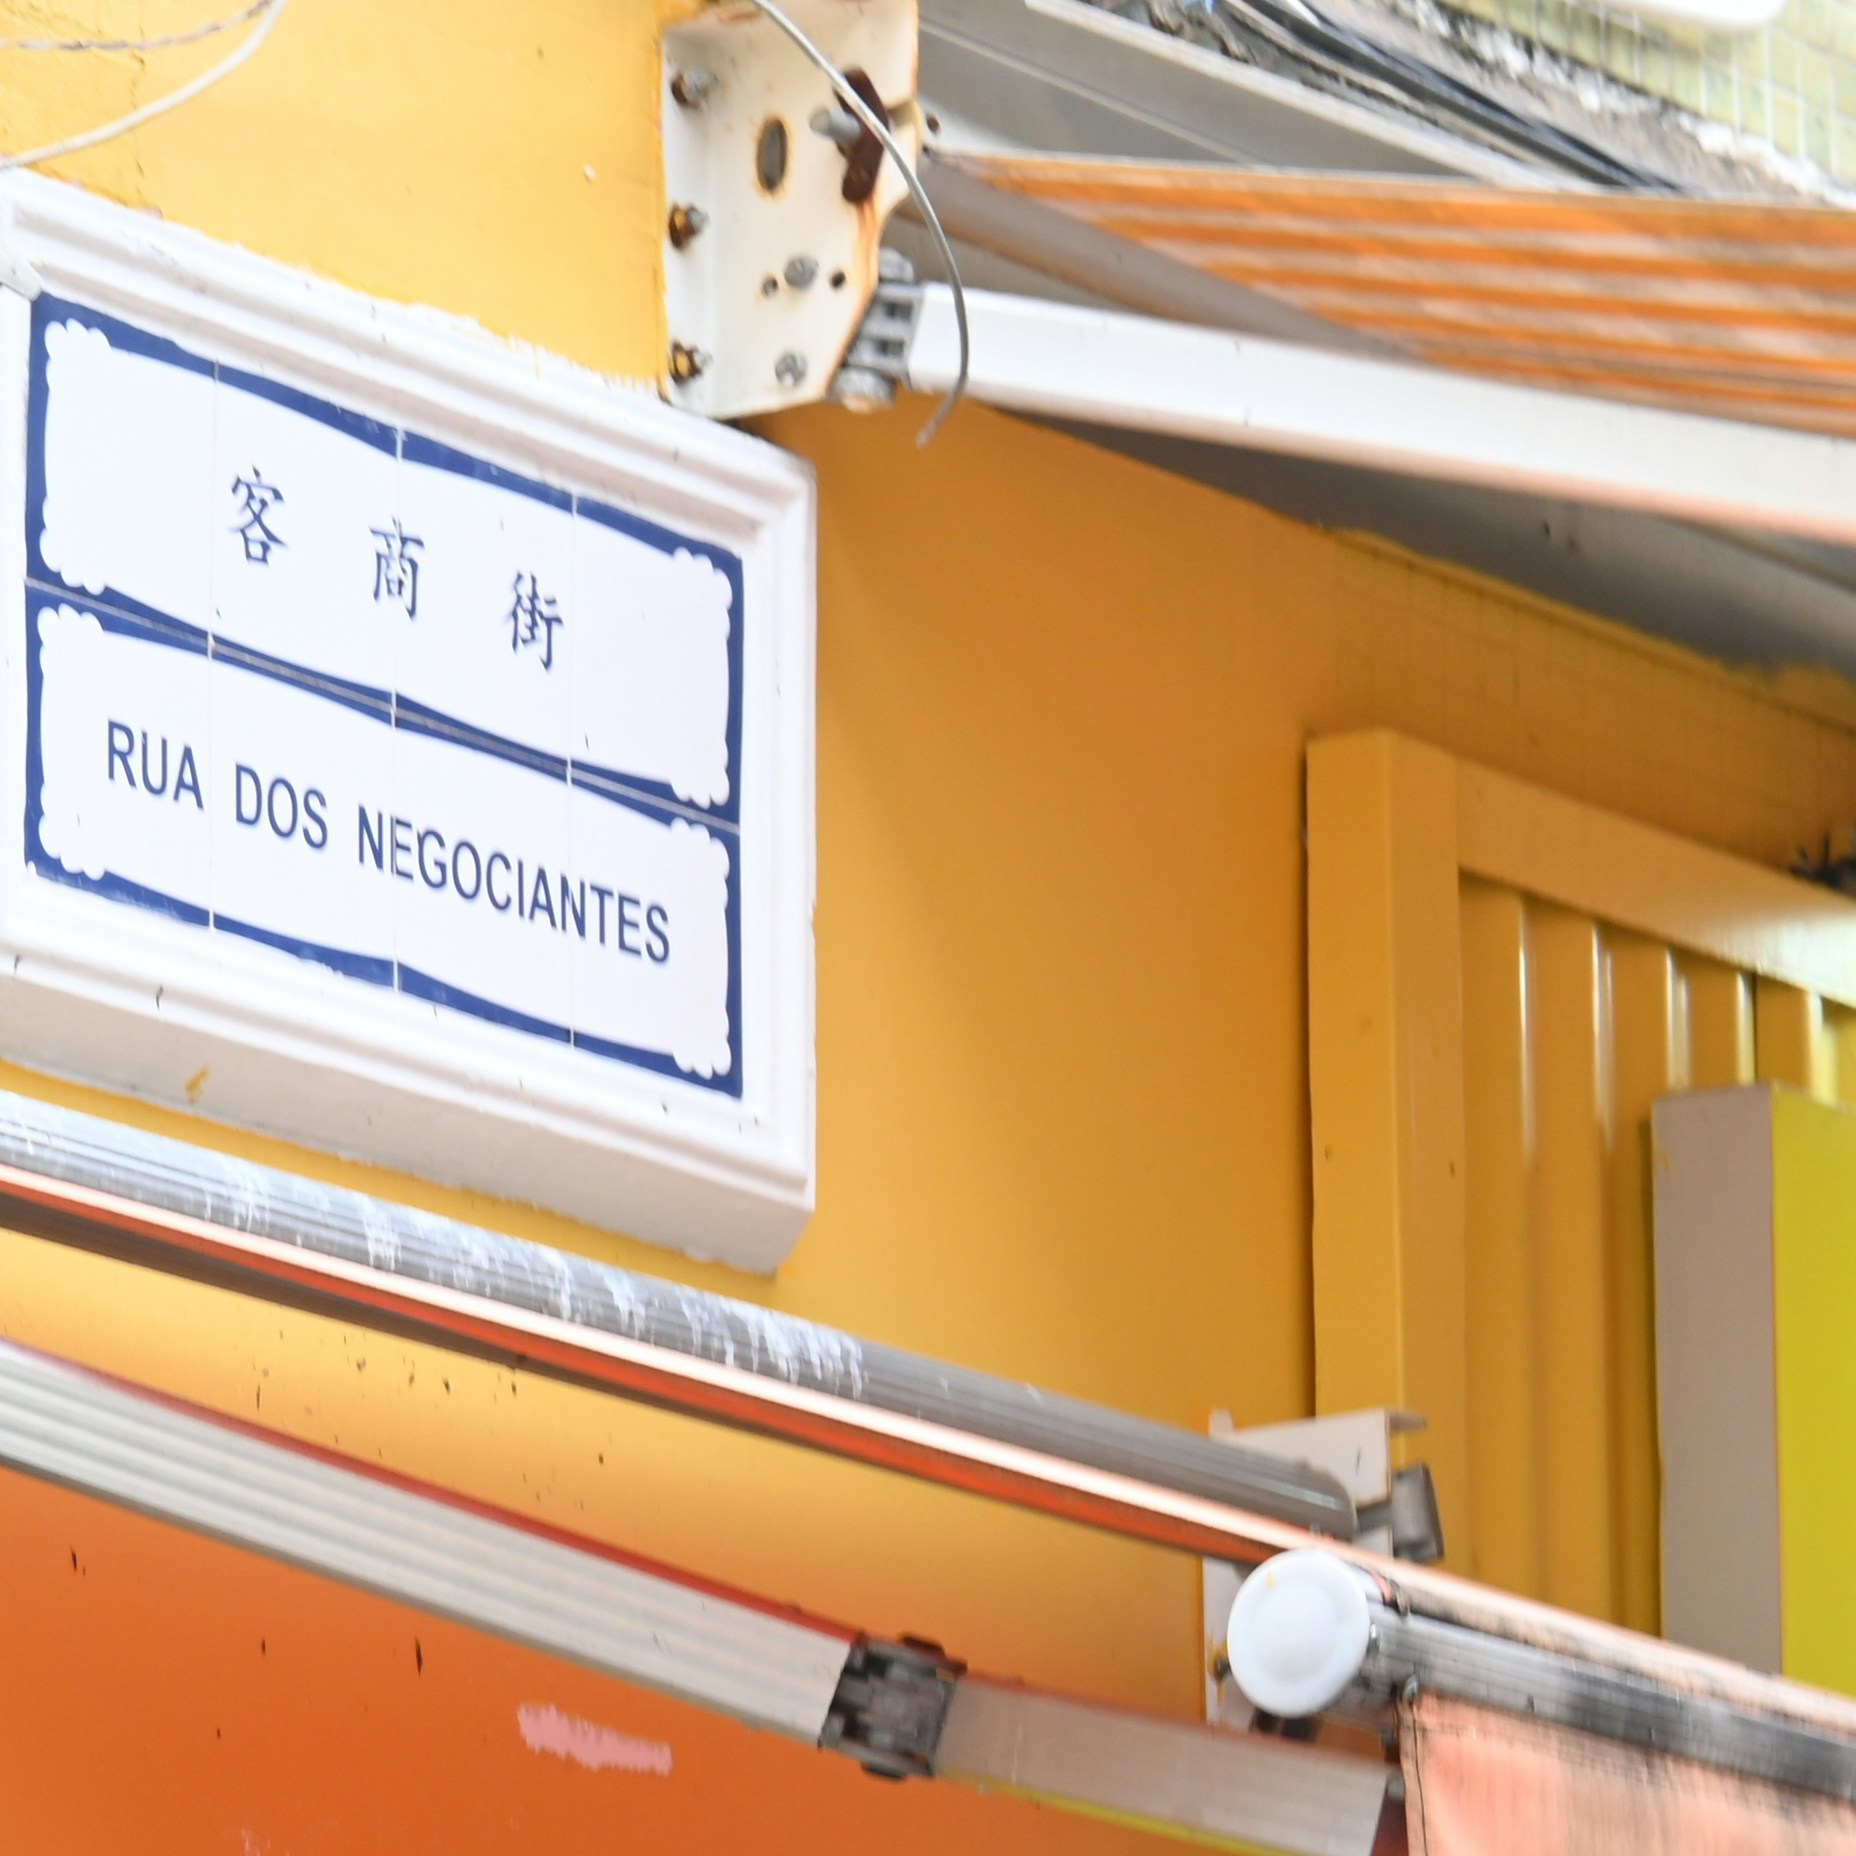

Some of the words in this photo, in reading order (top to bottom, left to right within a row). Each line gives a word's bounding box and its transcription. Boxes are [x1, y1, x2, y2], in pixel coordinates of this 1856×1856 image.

[228, 467, 563, 673] 客商街
[106, 720, 202, 808] RUA
[234, 763, 328, 851] DOS
[356, 806, 672, 964] NEGOCIANTES
